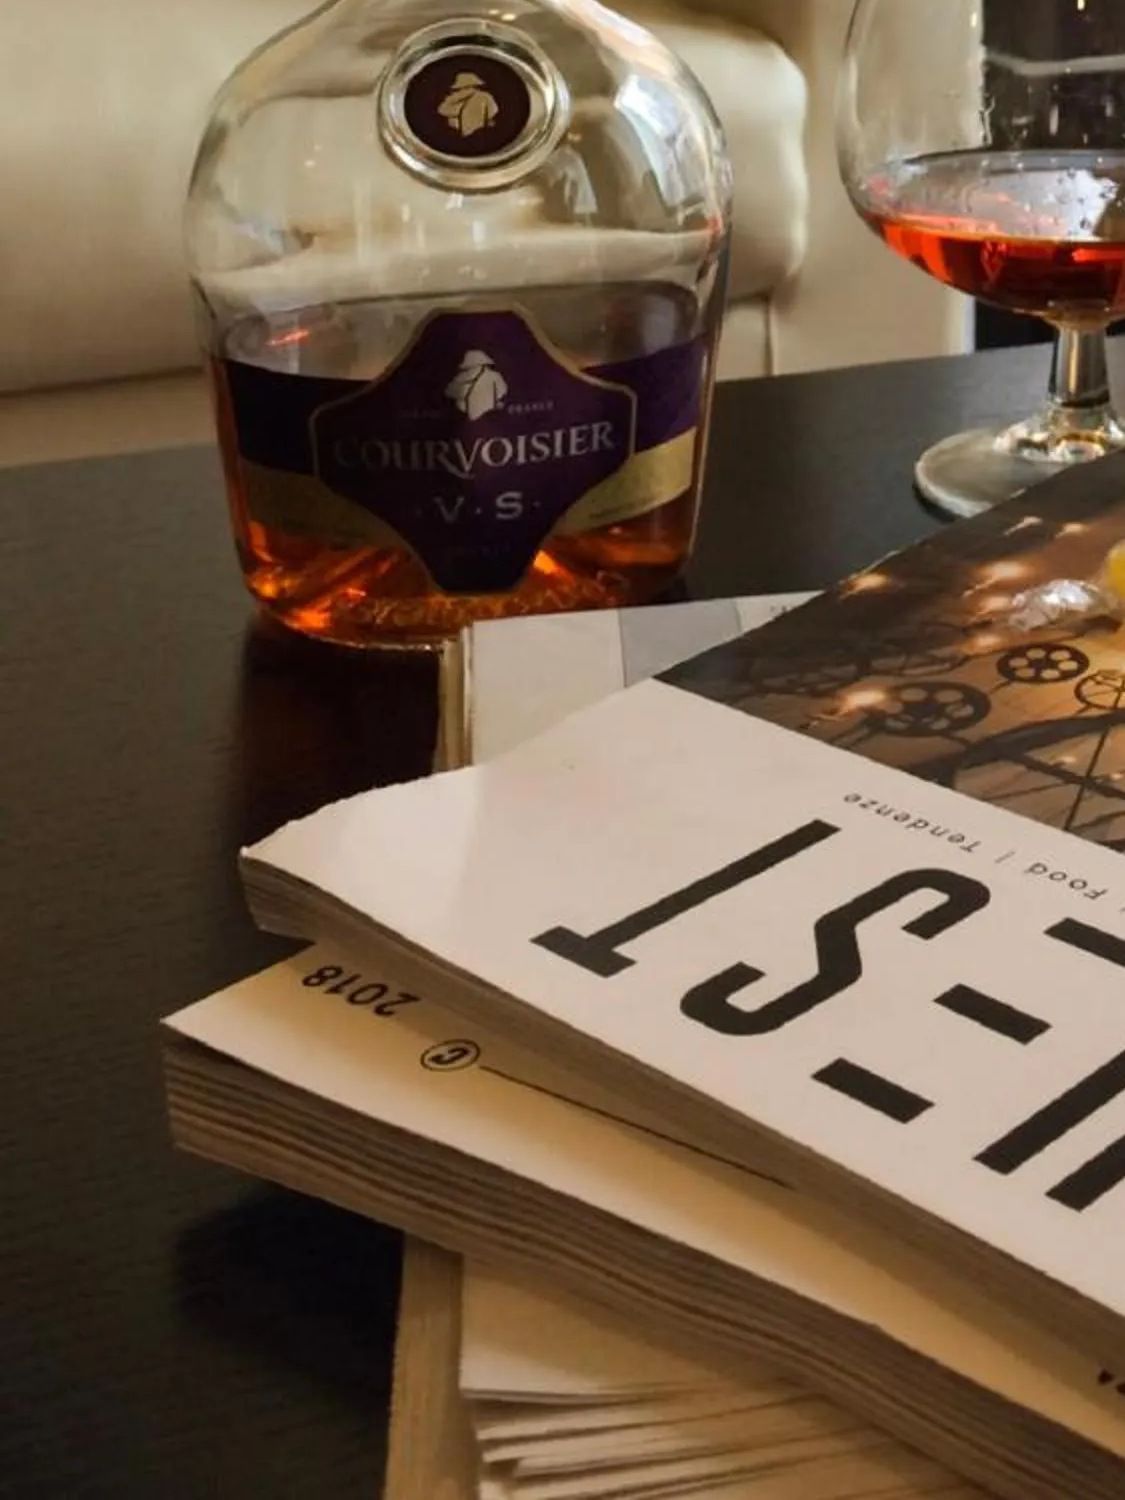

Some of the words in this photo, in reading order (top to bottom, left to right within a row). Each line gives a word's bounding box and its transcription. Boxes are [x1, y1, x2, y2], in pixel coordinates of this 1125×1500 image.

[334, 420, 614, 480] COURVOISIER
[842, 792, 983, 856] Tendenze
[1022, 861, 1108, 902] Food
[302, 965, 421, 1017] 2018
